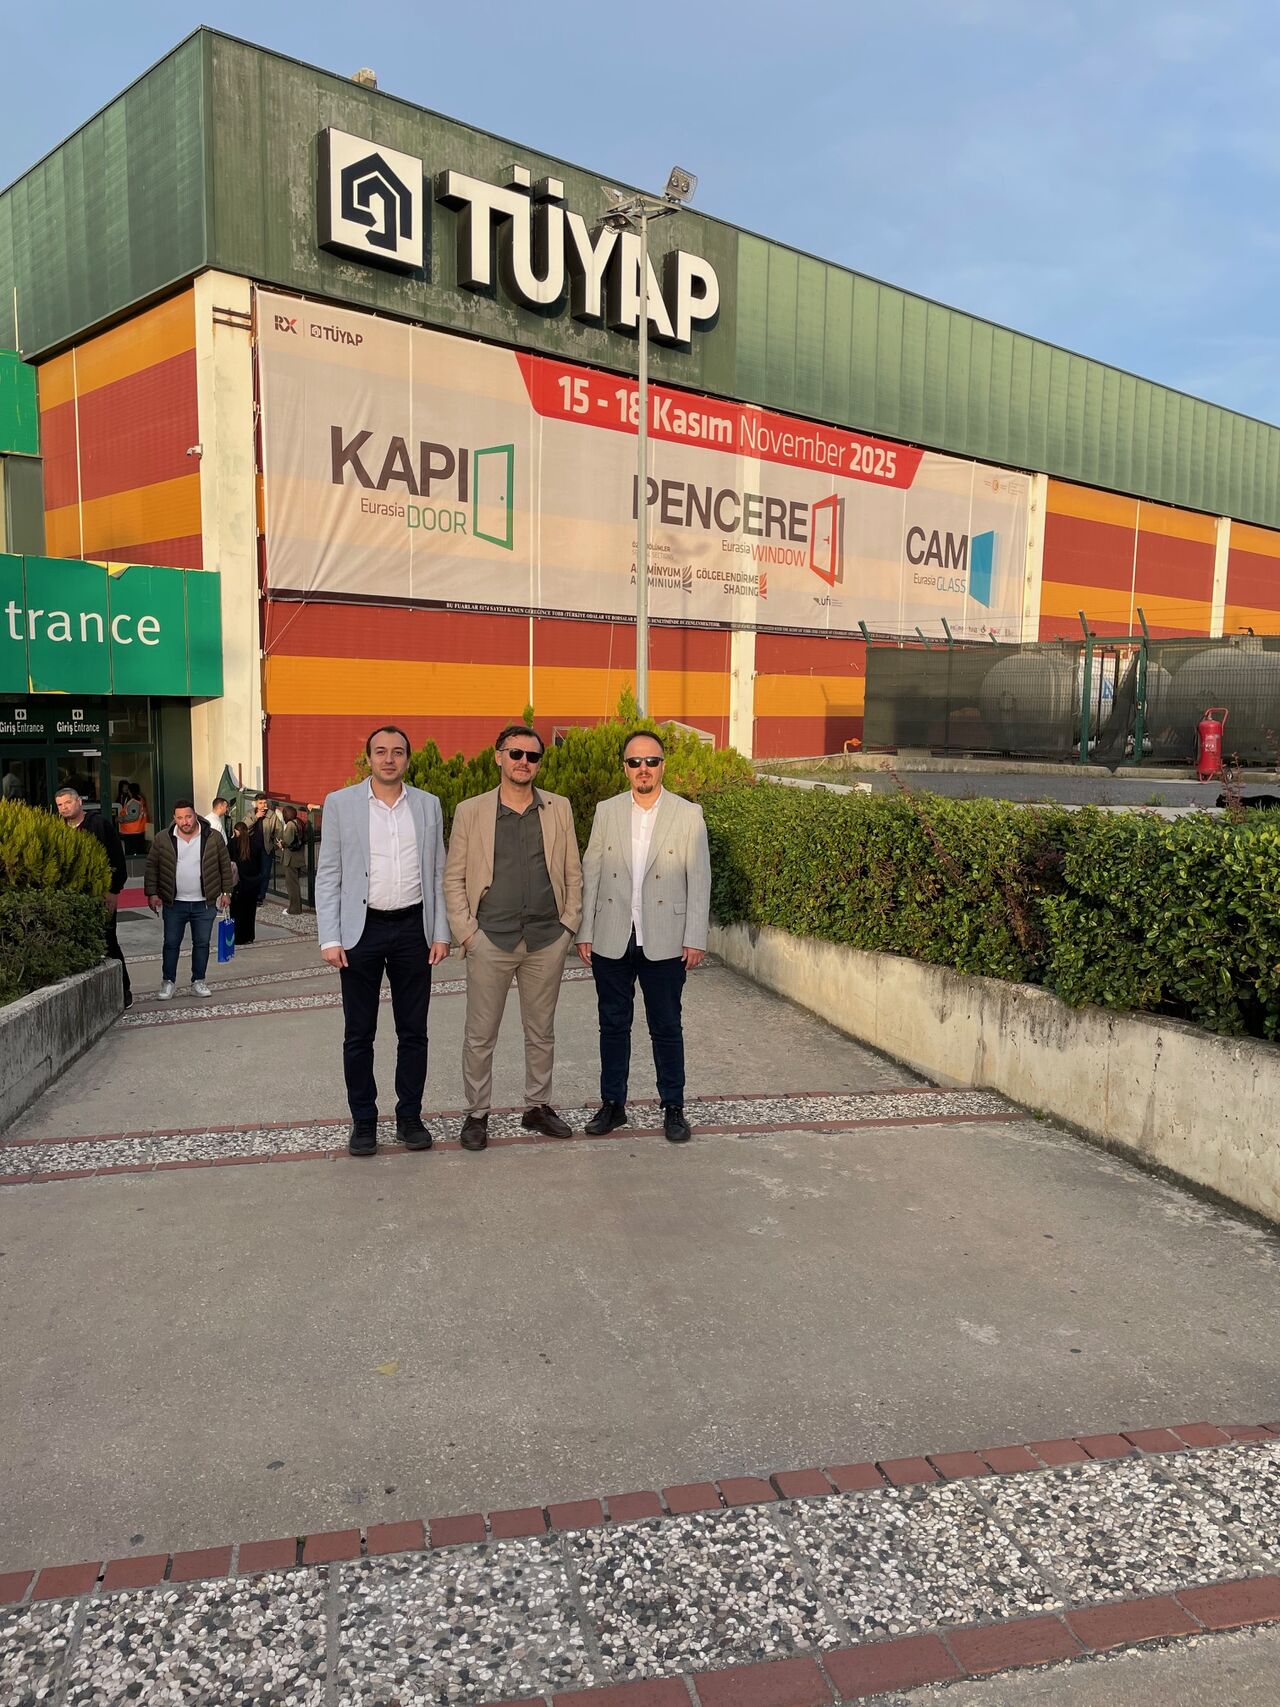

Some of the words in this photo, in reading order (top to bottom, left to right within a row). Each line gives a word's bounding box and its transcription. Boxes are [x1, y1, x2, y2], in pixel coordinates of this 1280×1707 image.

[440, 164, 721, 344] TÜYAP
[275, 315, 297, 335] RX
[323, 325, 363, 346] TÜYAP
[557, 375, 589, 414] 15
[615, 389, 640, 426] 18
[653, 395, 732, 445] Kasım
[739, 414, 846, 468] November
[849, 443, 897, 480] 2025
[331, 425, 469, 503] KAPI
[360, 498, 405, 518] Eurasia
[407, 505, 467, 535] DOOR
[632, 475, 809, 543] PENCERE
[721, 539, 751, 555] Eurasia
[751, 544, 807, 567] WINDOW
[906, 526, 968, 571] CAM
[630, 562, 681, 578] AMİNYUM
[630, 575, 681, 589] AMINIUM
[723, 583, 759, 597] SHADING
[913, 572, 936, 586] Eurasia
[936, 576, 967, 594] GLASS
[17, 721, 44, 733] Entrance
[57, 721, 73, 735] Giriş
[74, 721, 100, 733] Entrance
